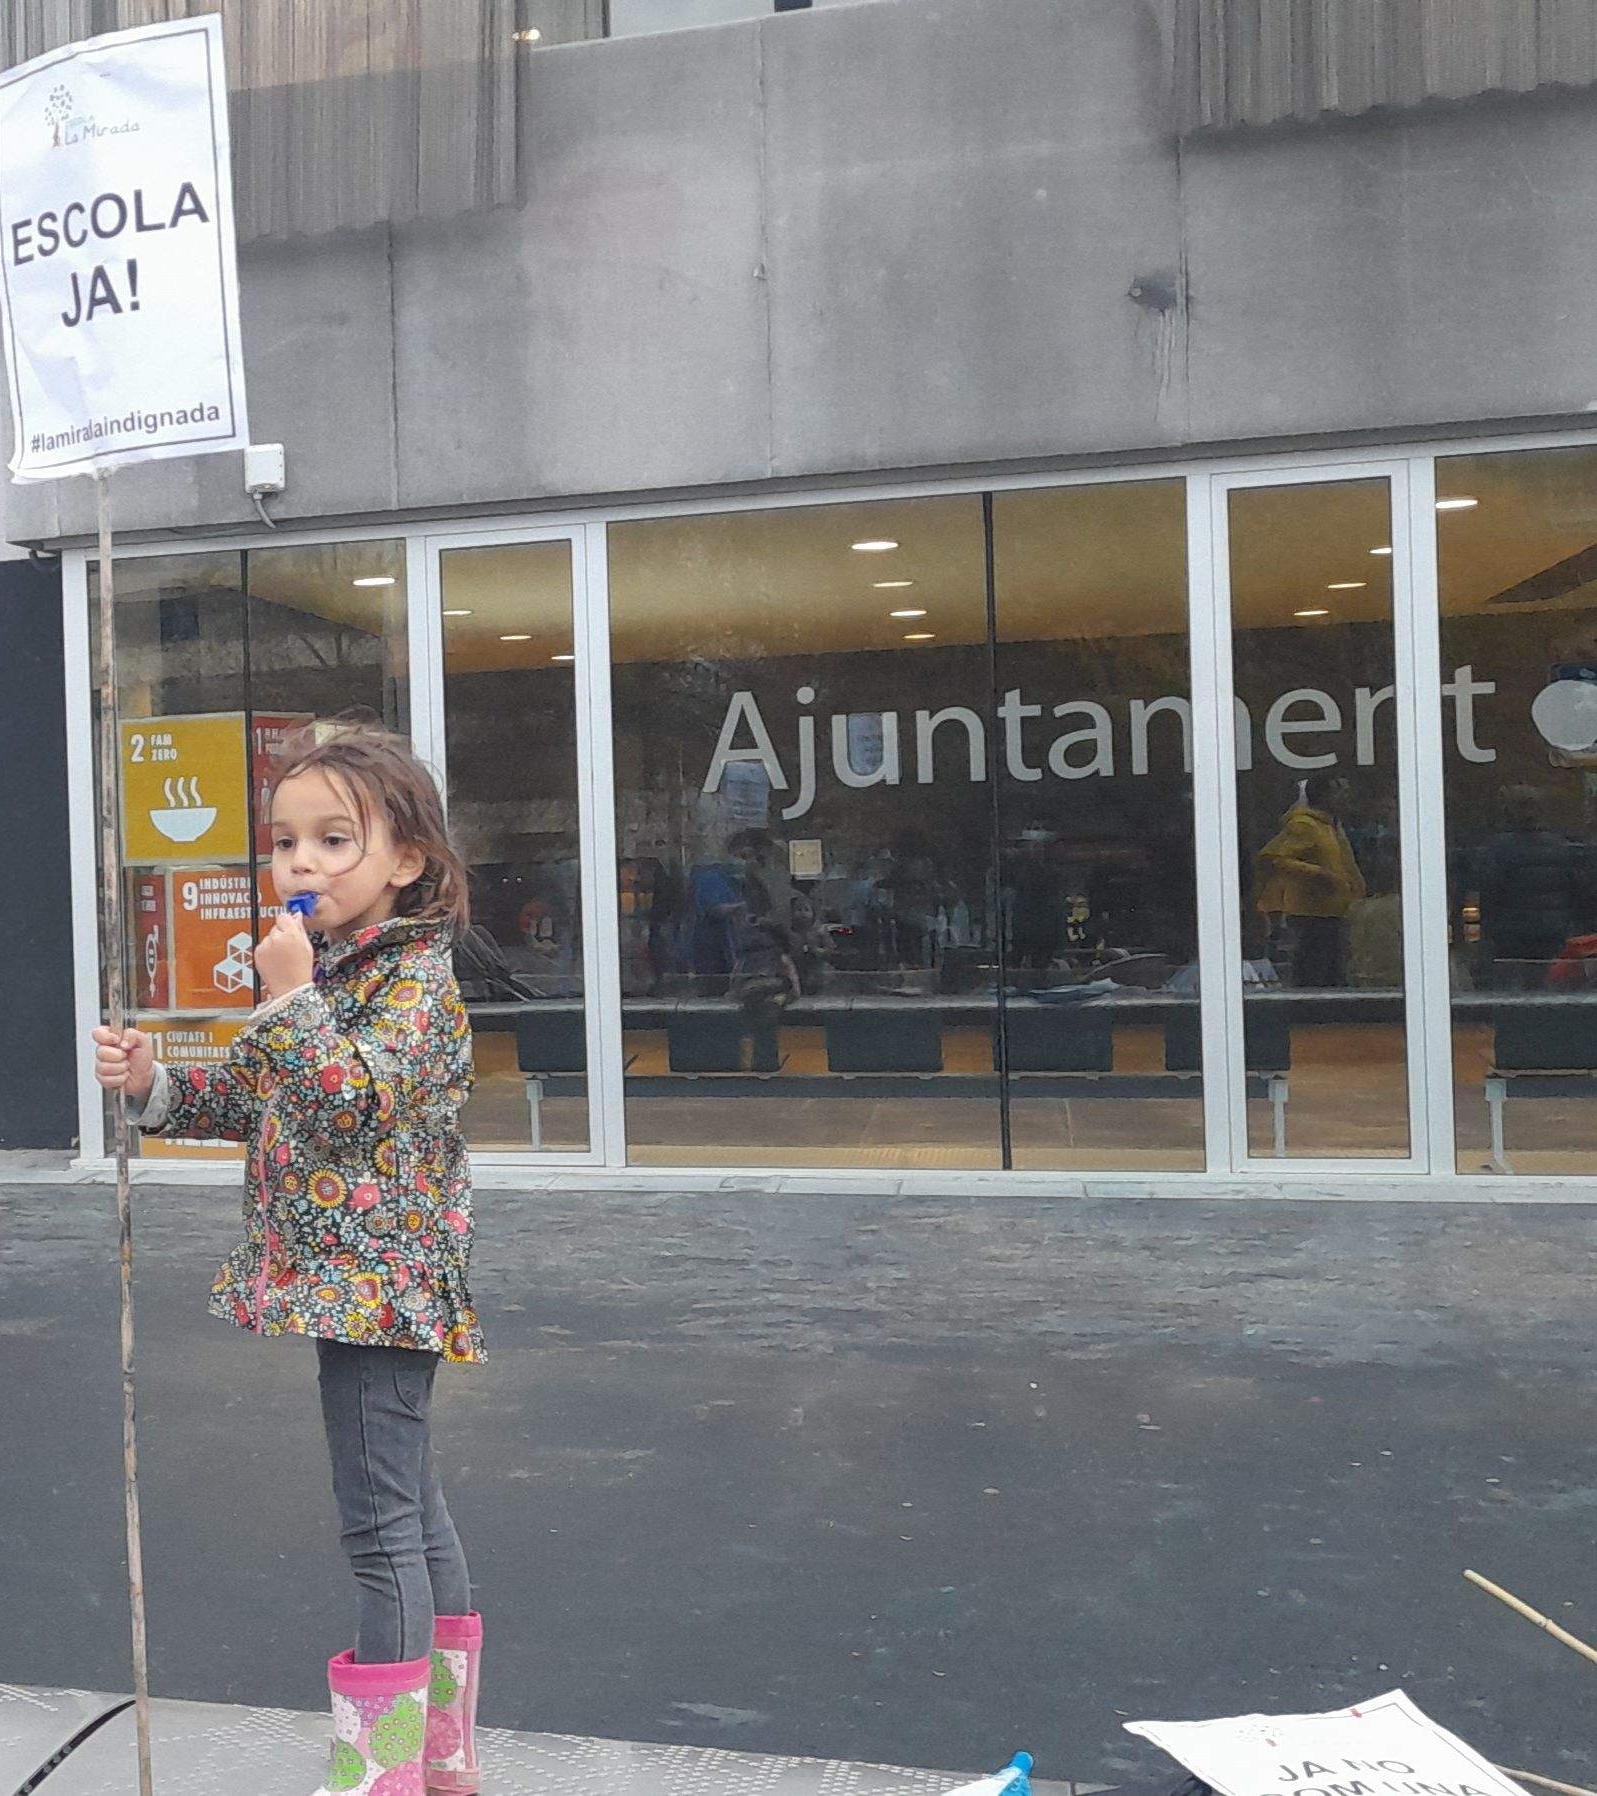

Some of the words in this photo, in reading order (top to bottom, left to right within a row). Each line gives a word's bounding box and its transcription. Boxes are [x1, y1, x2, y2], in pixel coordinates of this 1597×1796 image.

[11, 181, 210, 267] ESCOLA
[61, 258, 141, 328] JA!
[131, 734, 145, 763] 2
[150, 734, 173, 748] FAM
[150, 748, 178, 762] ZERO
[702, 663, 1496, 820] Ajuntament
[182, 882, 198, 911] 9
[200, 874, 259, 891] INDÚSTRI
[166, 1031, 205, 1043] CIUTATS
[167, 1046, 230, 1059] COMUNITATS
[1278, 1760, 1337, 1782] JA
